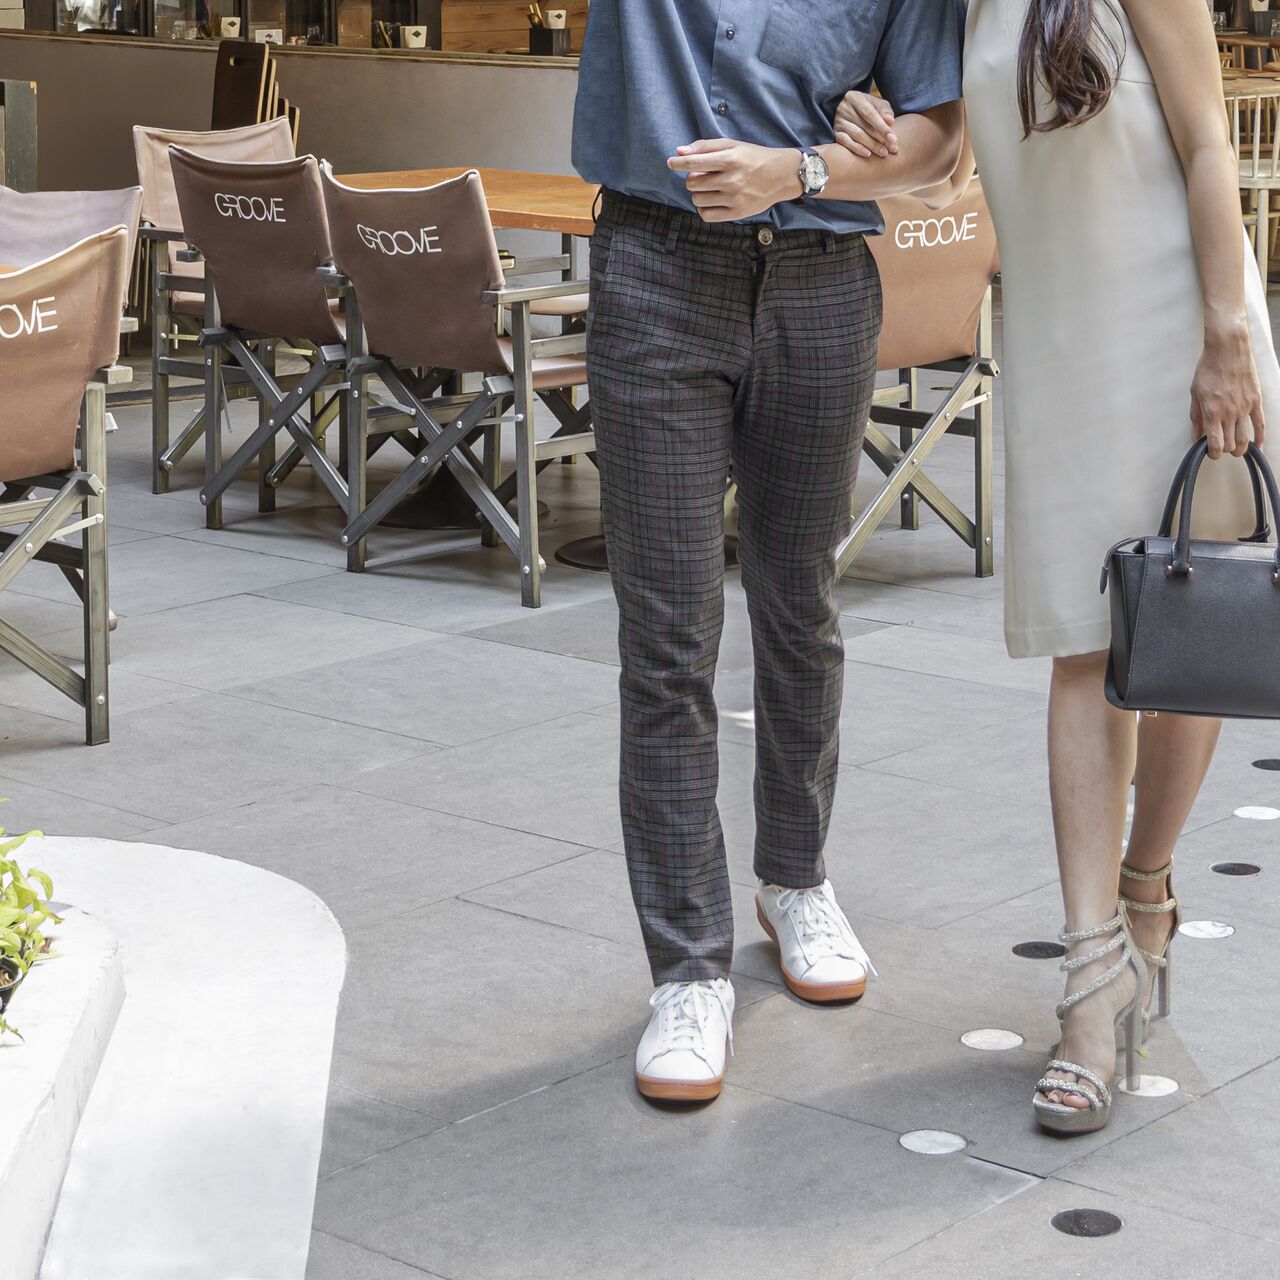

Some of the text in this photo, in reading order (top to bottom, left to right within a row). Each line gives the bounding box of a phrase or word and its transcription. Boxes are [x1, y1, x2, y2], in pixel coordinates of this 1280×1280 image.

[214, 192, 287, 223] GROOVE
[356, 223, 442, 256] GROOVE
[895, 212, 978, 249] GROOVE
